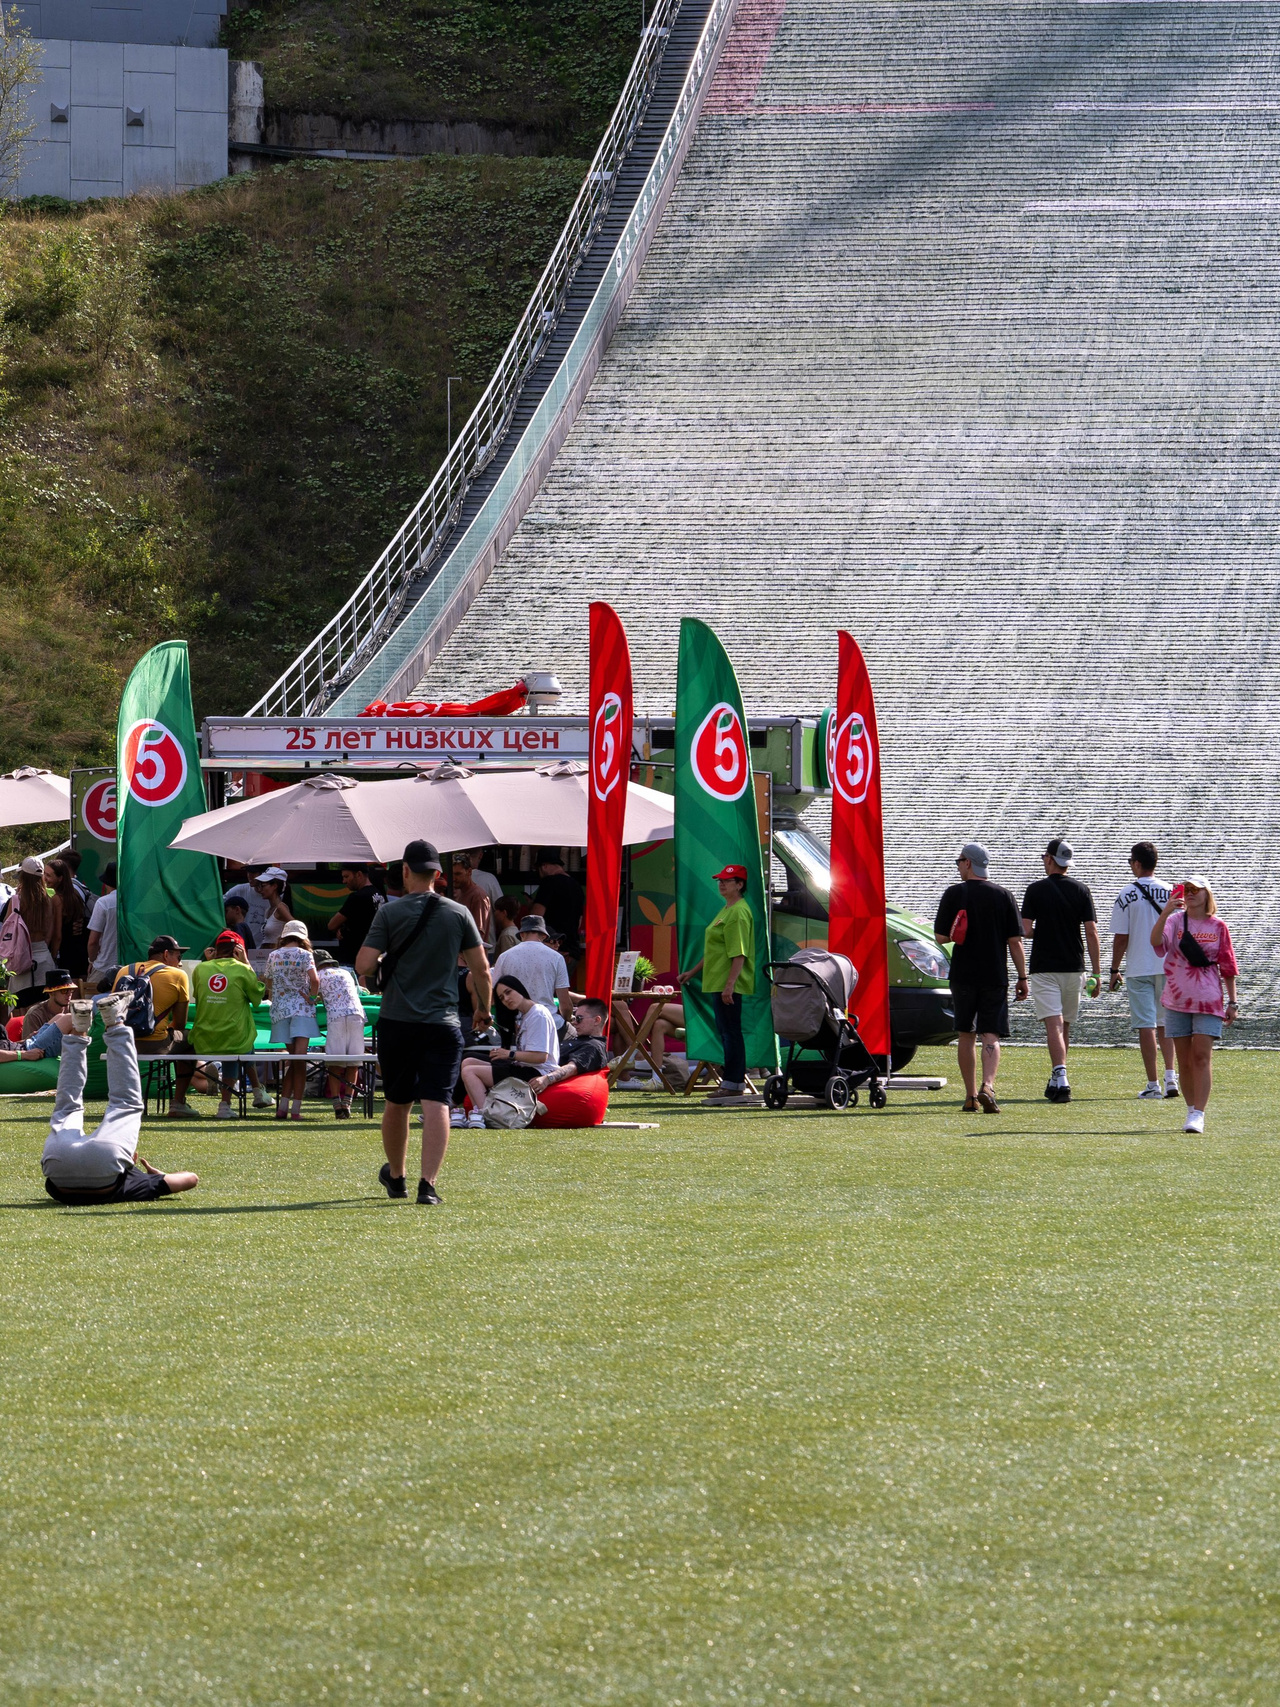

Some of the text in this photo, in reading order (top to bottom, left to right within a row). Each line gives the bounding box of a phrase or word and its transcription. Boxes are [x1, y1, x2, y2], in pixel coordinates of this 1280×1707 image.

[286, 727, 559, 752] 25 лет низких цен
[1114, 888, 1138, 912] Los
